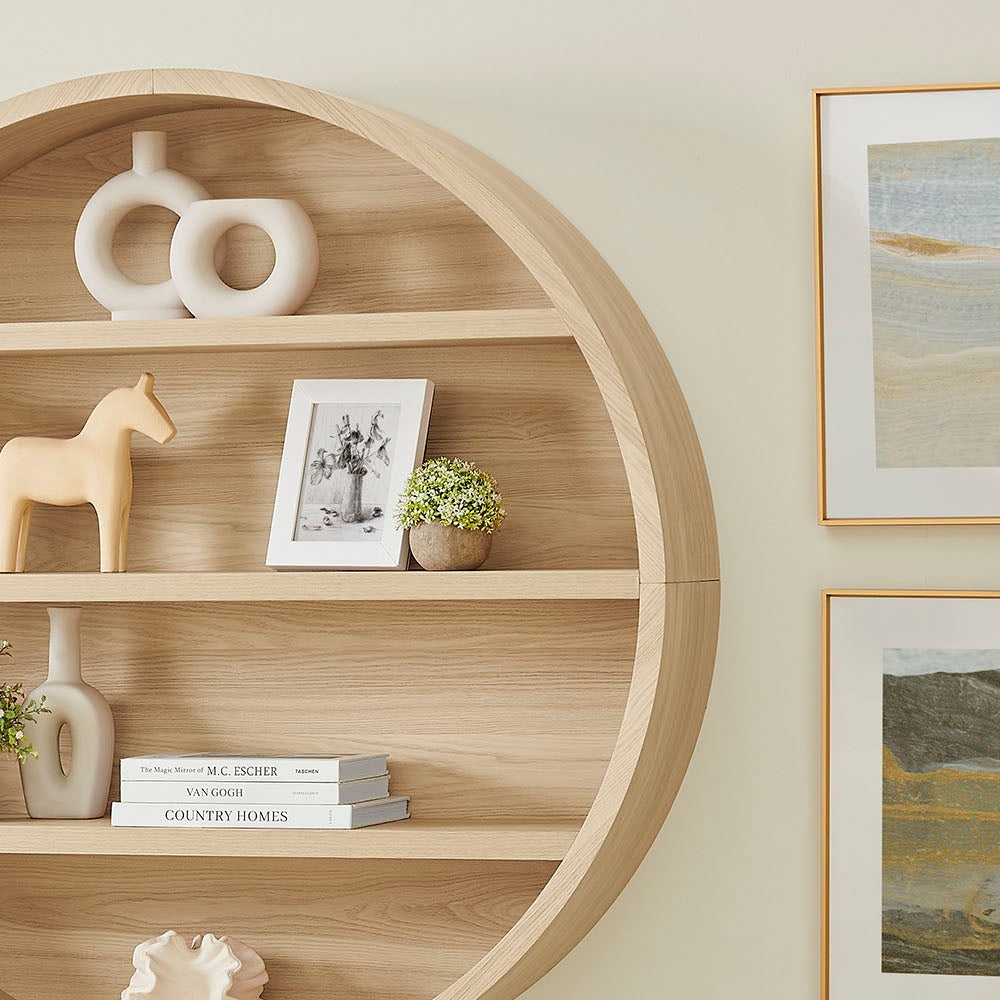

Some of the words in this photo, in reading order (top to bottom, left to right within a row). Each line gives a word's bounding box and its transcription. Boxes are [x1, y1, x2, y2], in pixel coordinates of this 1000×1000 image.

[154, 766, 172, 774] Magic
[207, 766, 231, 776] M.C.
[234, 766, 278, 776] ESCHER
[186, 787, 209, 797] VAN
[211, 788, 243, 797] GOGH
[165, 809, 232, 821] COUNTRY
[237, 810, 288, 822] HOMES
